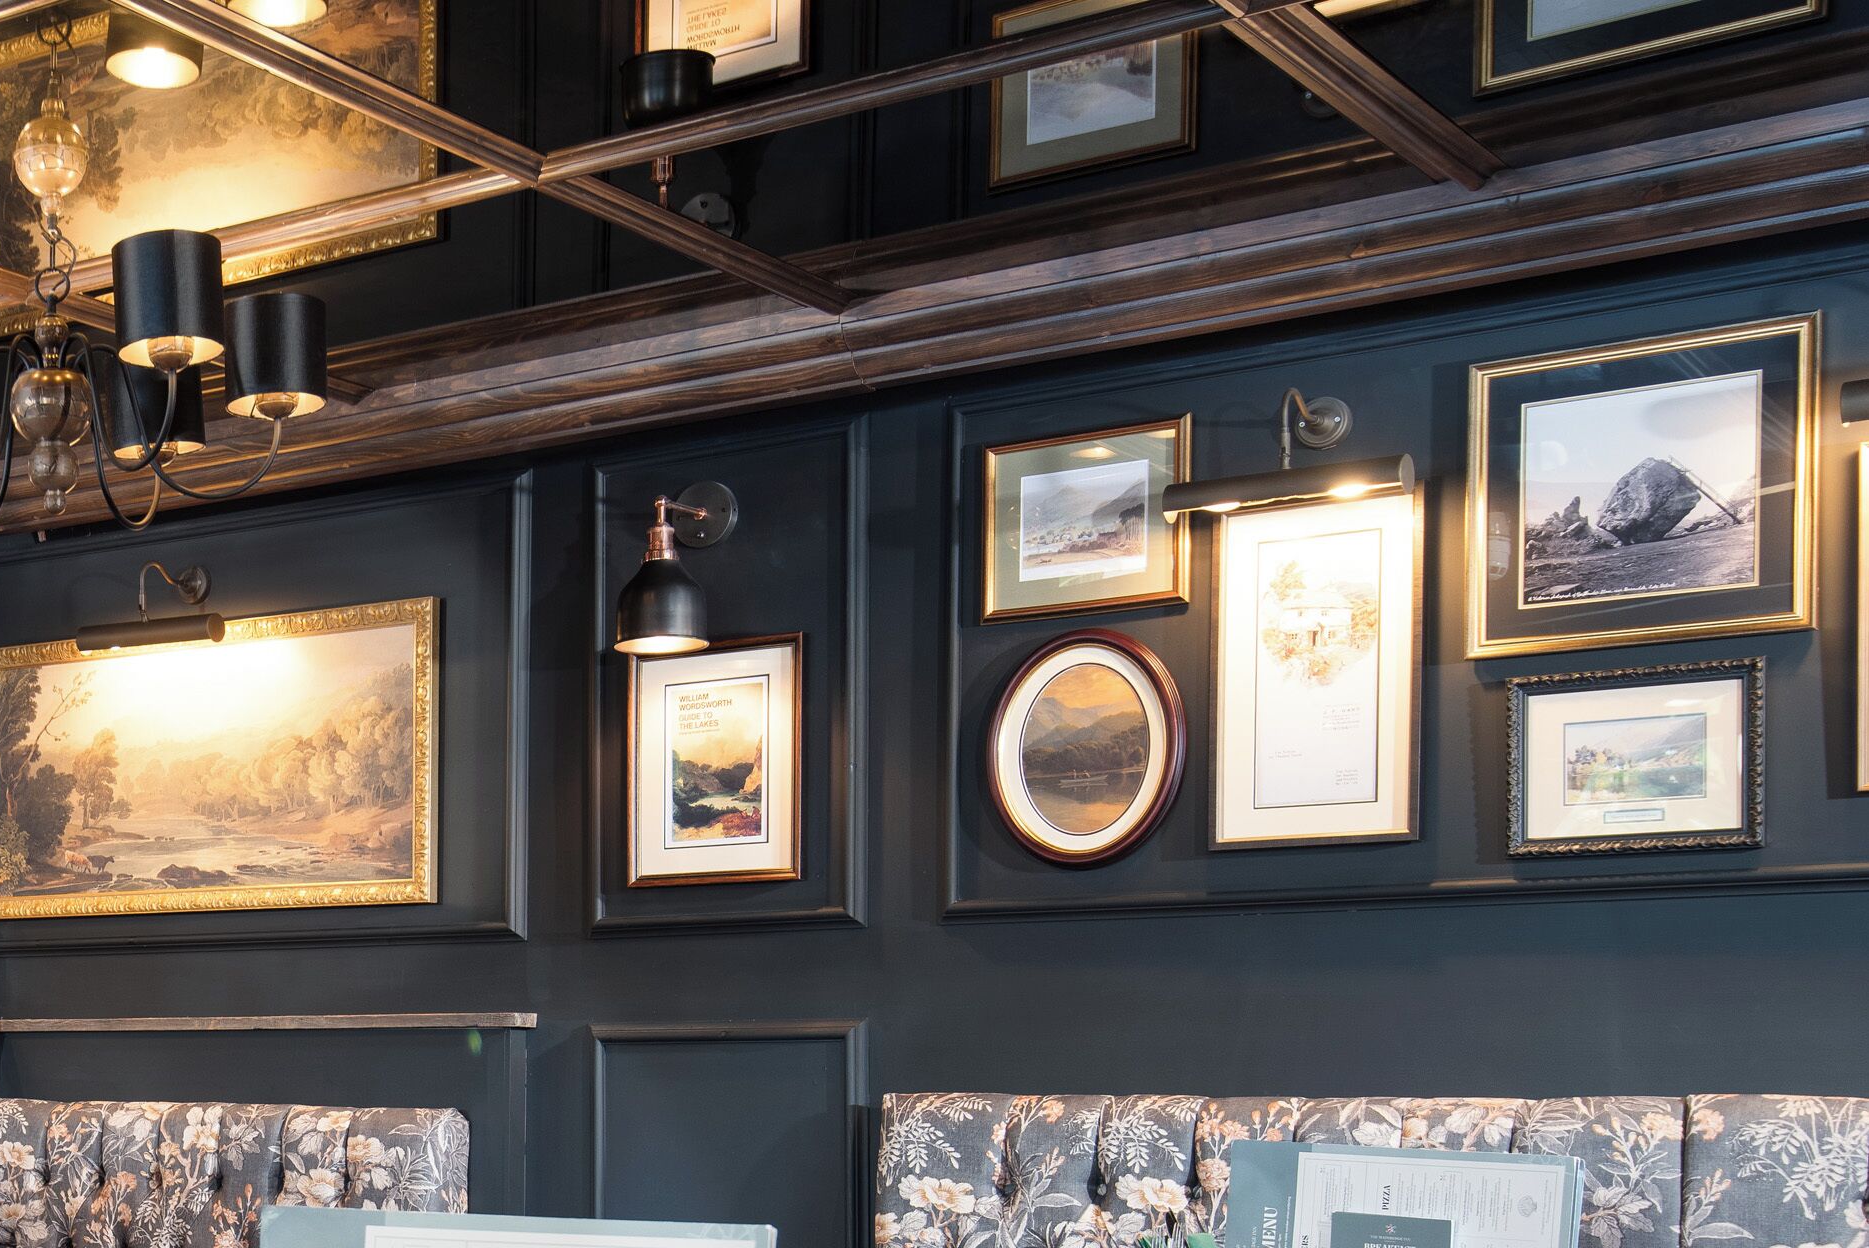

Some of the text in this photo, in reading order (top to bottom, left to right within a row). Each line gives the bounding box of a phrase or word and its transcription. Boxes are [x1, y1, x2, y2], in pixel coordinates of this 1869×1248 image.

[679, 693, 709, 703] WILLIAM
[679, 699, 732, 711] WORDSWORTH
[704, 711, 713, 719] TO
[680, 719, 719, 730] THE LAKES
[1382, 1184, 1391, 1210] PIZZA
